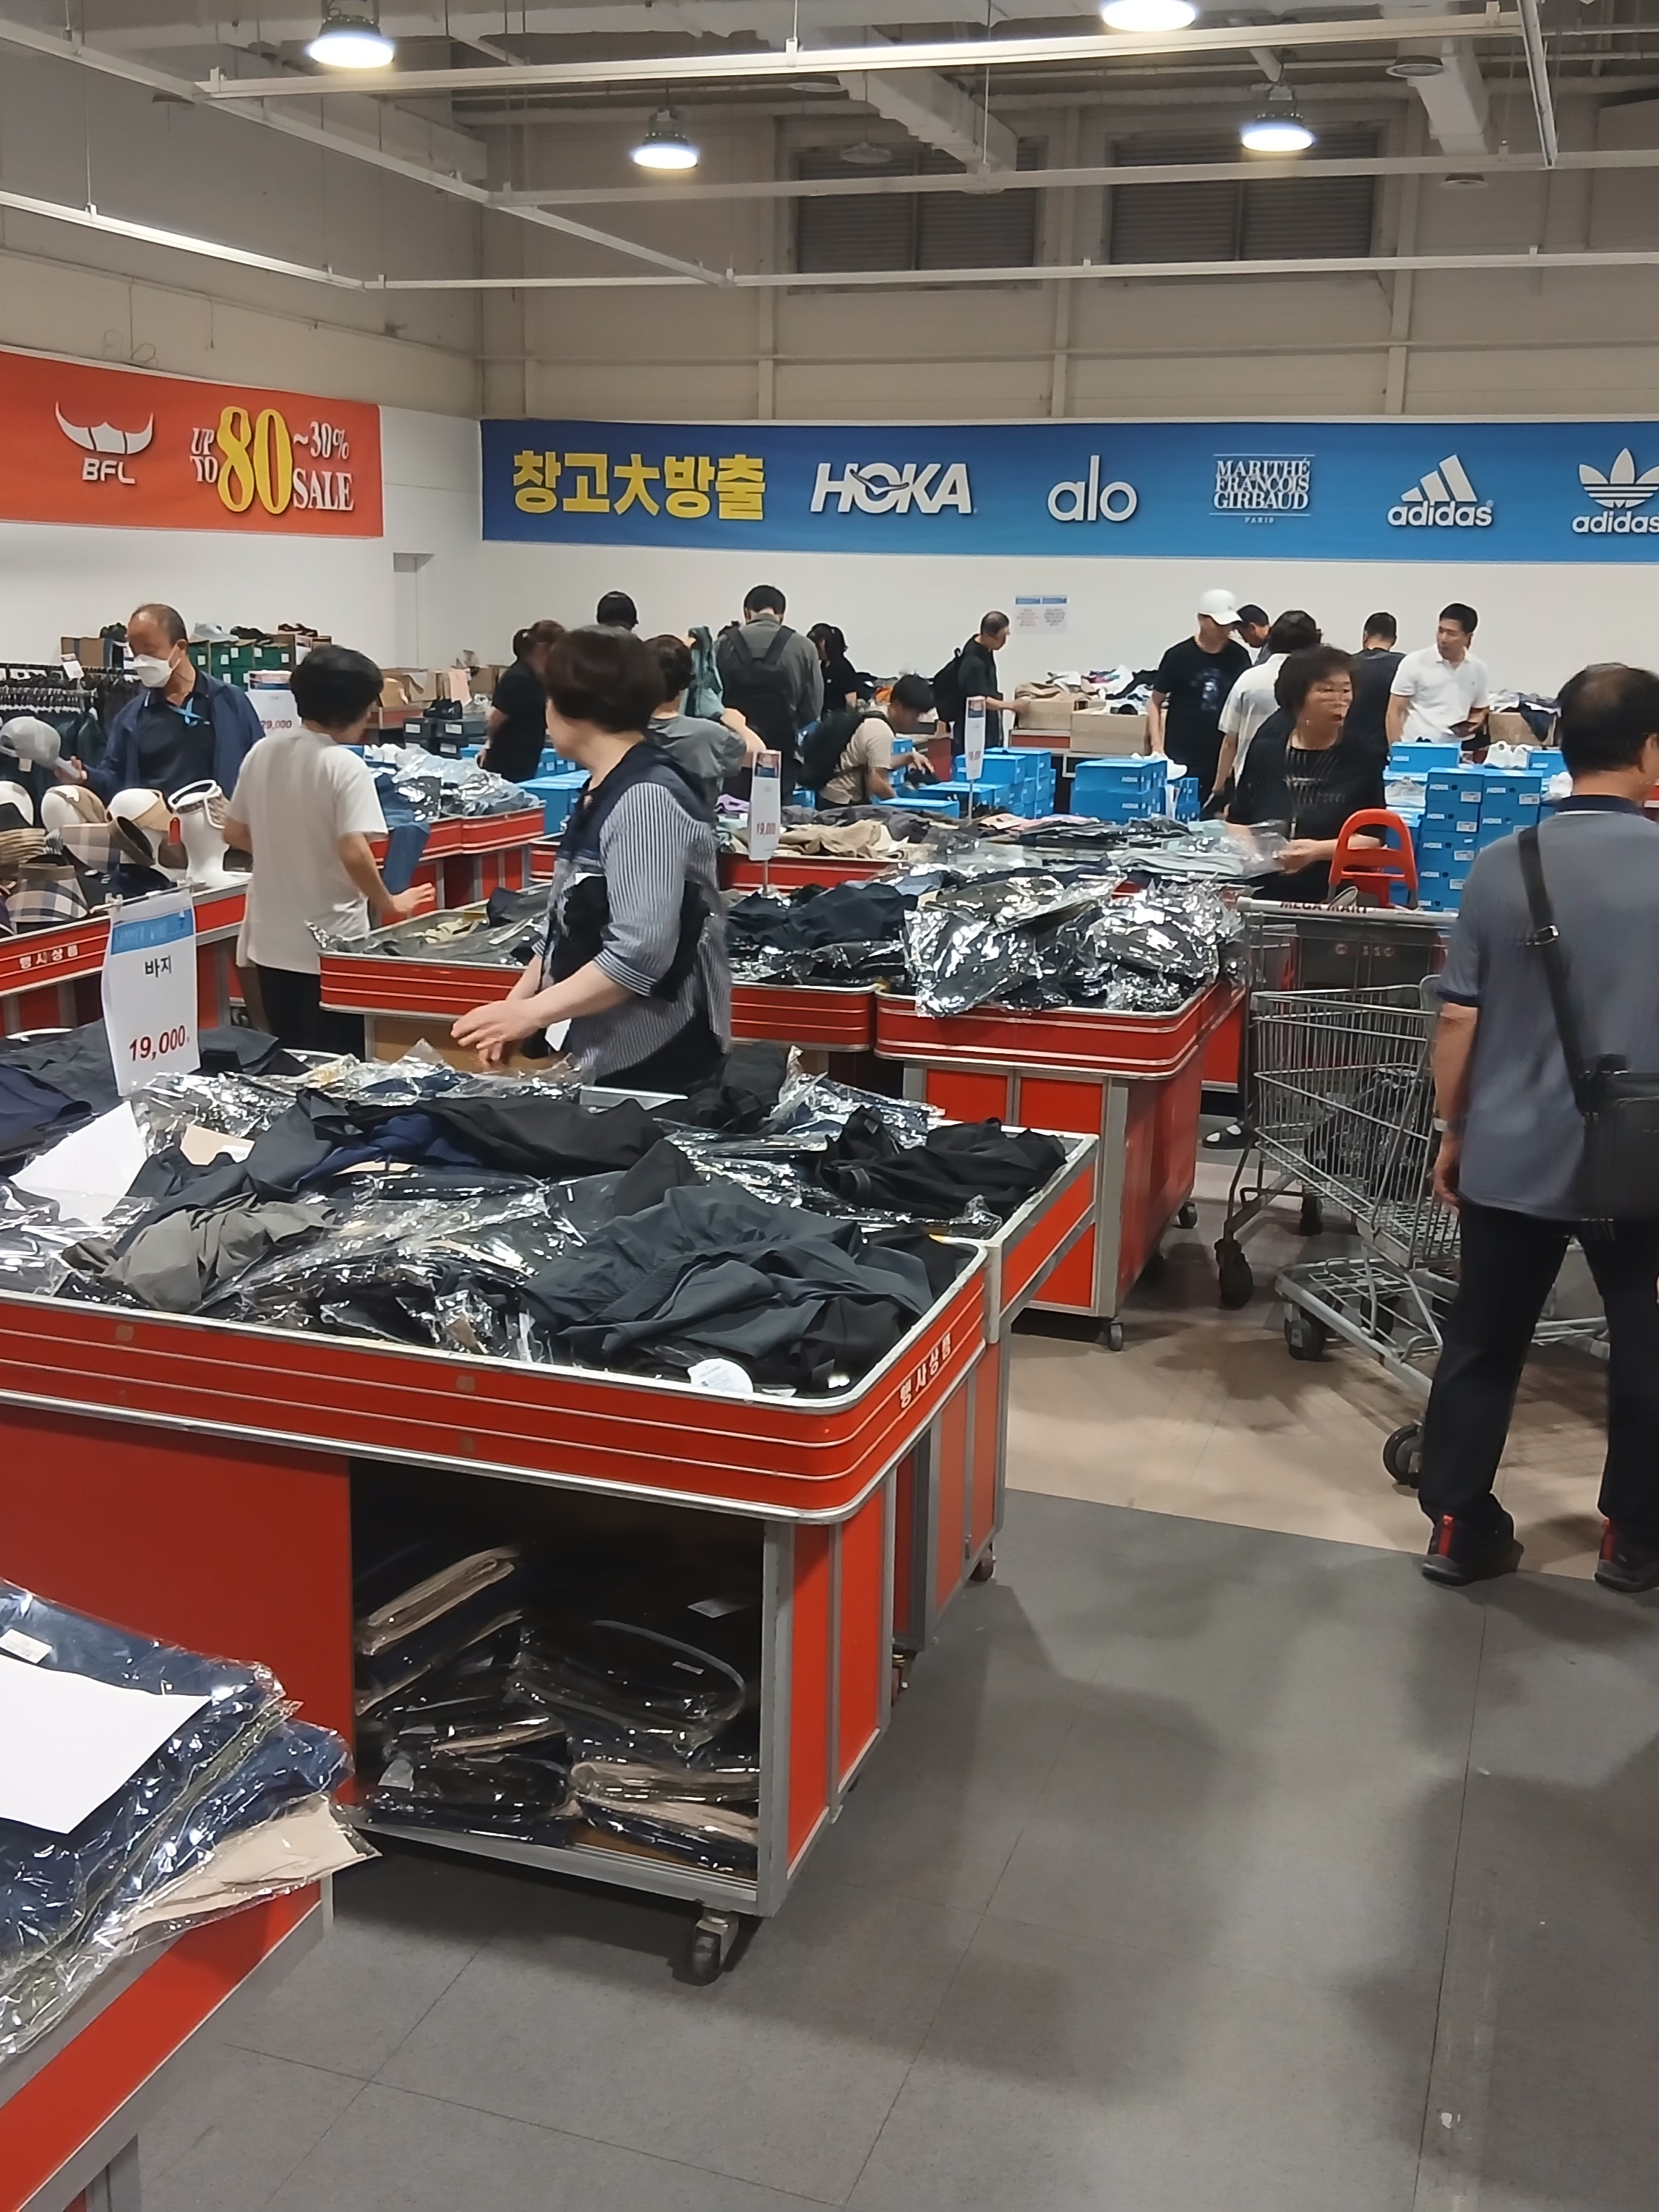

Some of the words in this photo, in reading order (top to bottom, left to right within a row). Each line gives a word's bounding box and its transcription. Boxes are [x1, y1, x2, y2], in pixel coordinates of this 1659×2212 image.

[192, 427, 215, 455] UP
[82, 458, 136, 485] BFL
[189, 456, 218, 483] TO
[217, 406, 293, 514] 80
[293, 421, 349, 459] ~30%
[1216, 457, 1310, 476] MARITHÉ
[293, 468, 354, 511] SALE
[513, 450, 766, 520] 창고大방출
[810, 462, 973, 514] HOKA
[1047, 454, 1138, 521] alo
[1213, 492, 1309, 510] GIRBAUD
[1386, 499, 1492, 526] adidas
[1572, 510, 1659, 533] adidas
[145, 955, 172, 978] 바지
[129, 1025, 186, 1061] 19,000
